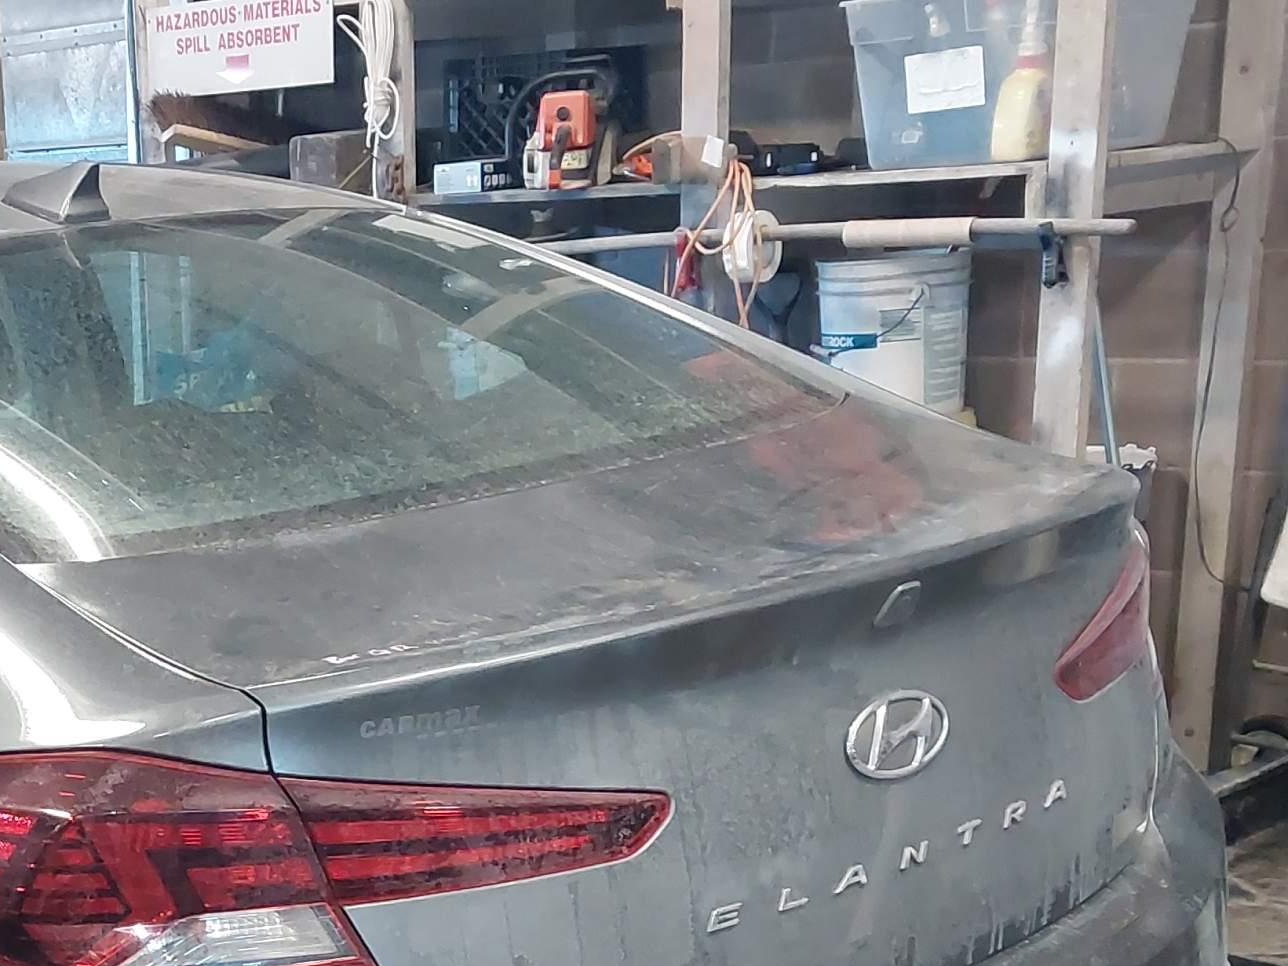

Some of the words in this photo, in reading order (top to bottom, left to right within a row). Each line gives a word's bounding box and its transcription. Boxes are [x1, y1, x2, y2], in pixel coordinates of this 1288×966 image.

[155, 8, 237, 33] HAZARDOUS
[243, 0, 322, 21] MATERIALS
[176, 35, 211, 55] SPILL
[218, 24, 300, 51] ABSORBENT
[706, 778, 1069, 934] ELANTRA
